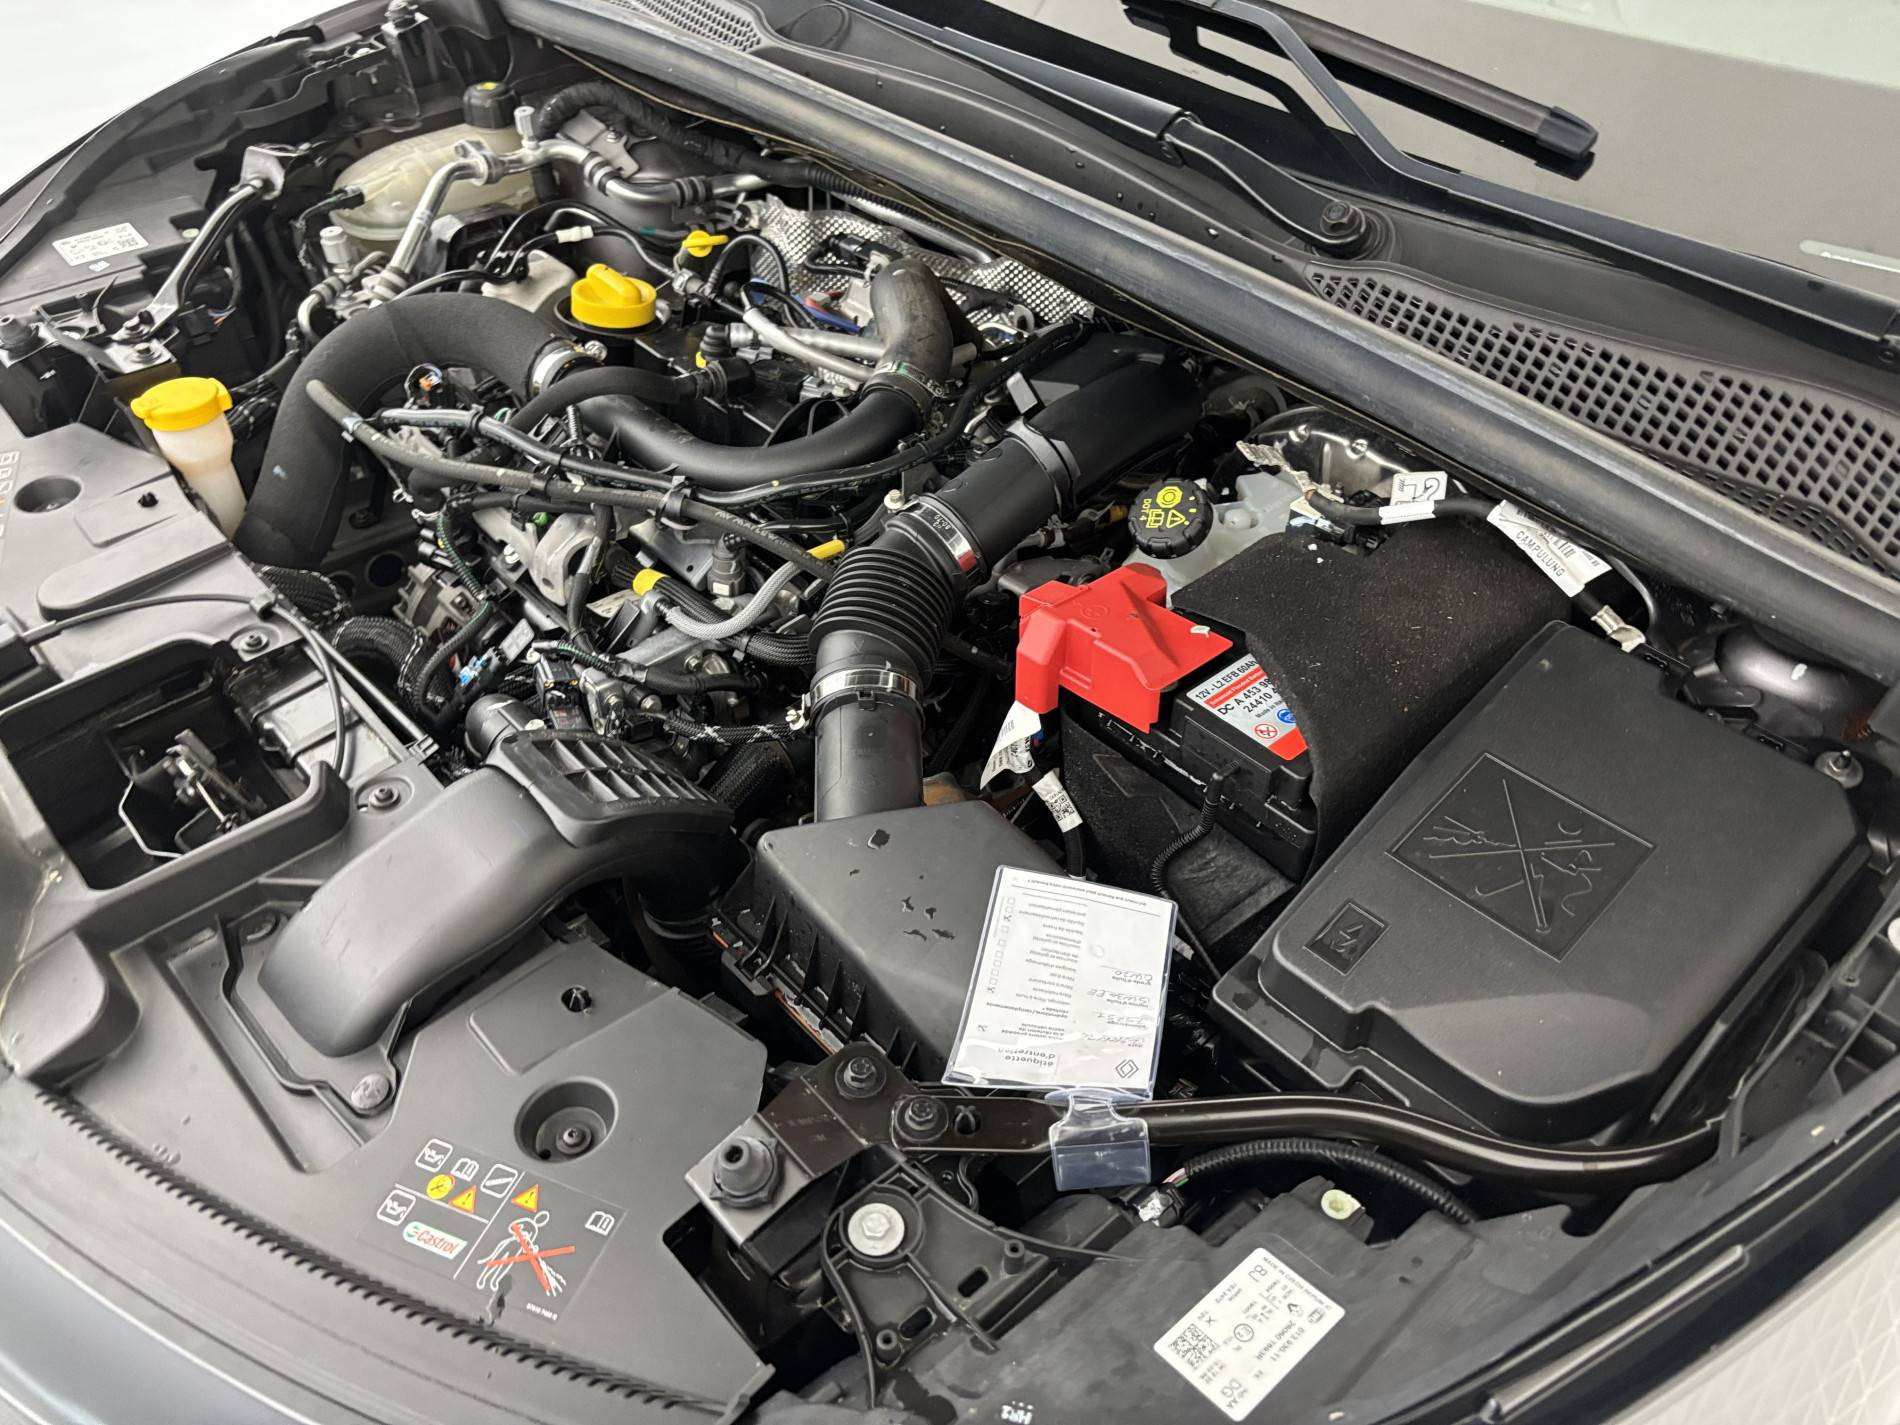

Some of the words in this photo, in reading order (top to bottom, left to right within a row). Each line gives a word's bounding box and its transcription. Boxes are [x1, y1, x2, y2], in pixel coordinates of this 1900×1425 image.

[1141, 498, 1152, 513] DOT
[1515, 530, 1565, 577] CAMPULUNG
[1195, 687, 1211, 700] 12V
[1215, 680, 1226, 691] L2
[1223, 669, 1239, 685] EFB
[1237, 660, 1257, 674] 60Ah
[1234, 697, 1243, 706] A
[1243, 685, 1262, 700] 453
[1243, 692, 1273, 713] 24410
[416, 1230, 459, 1254] Castrol
[1247, 1264, 1267, 1281] 8J
[1220, 1378, 1241, 1398] DG
